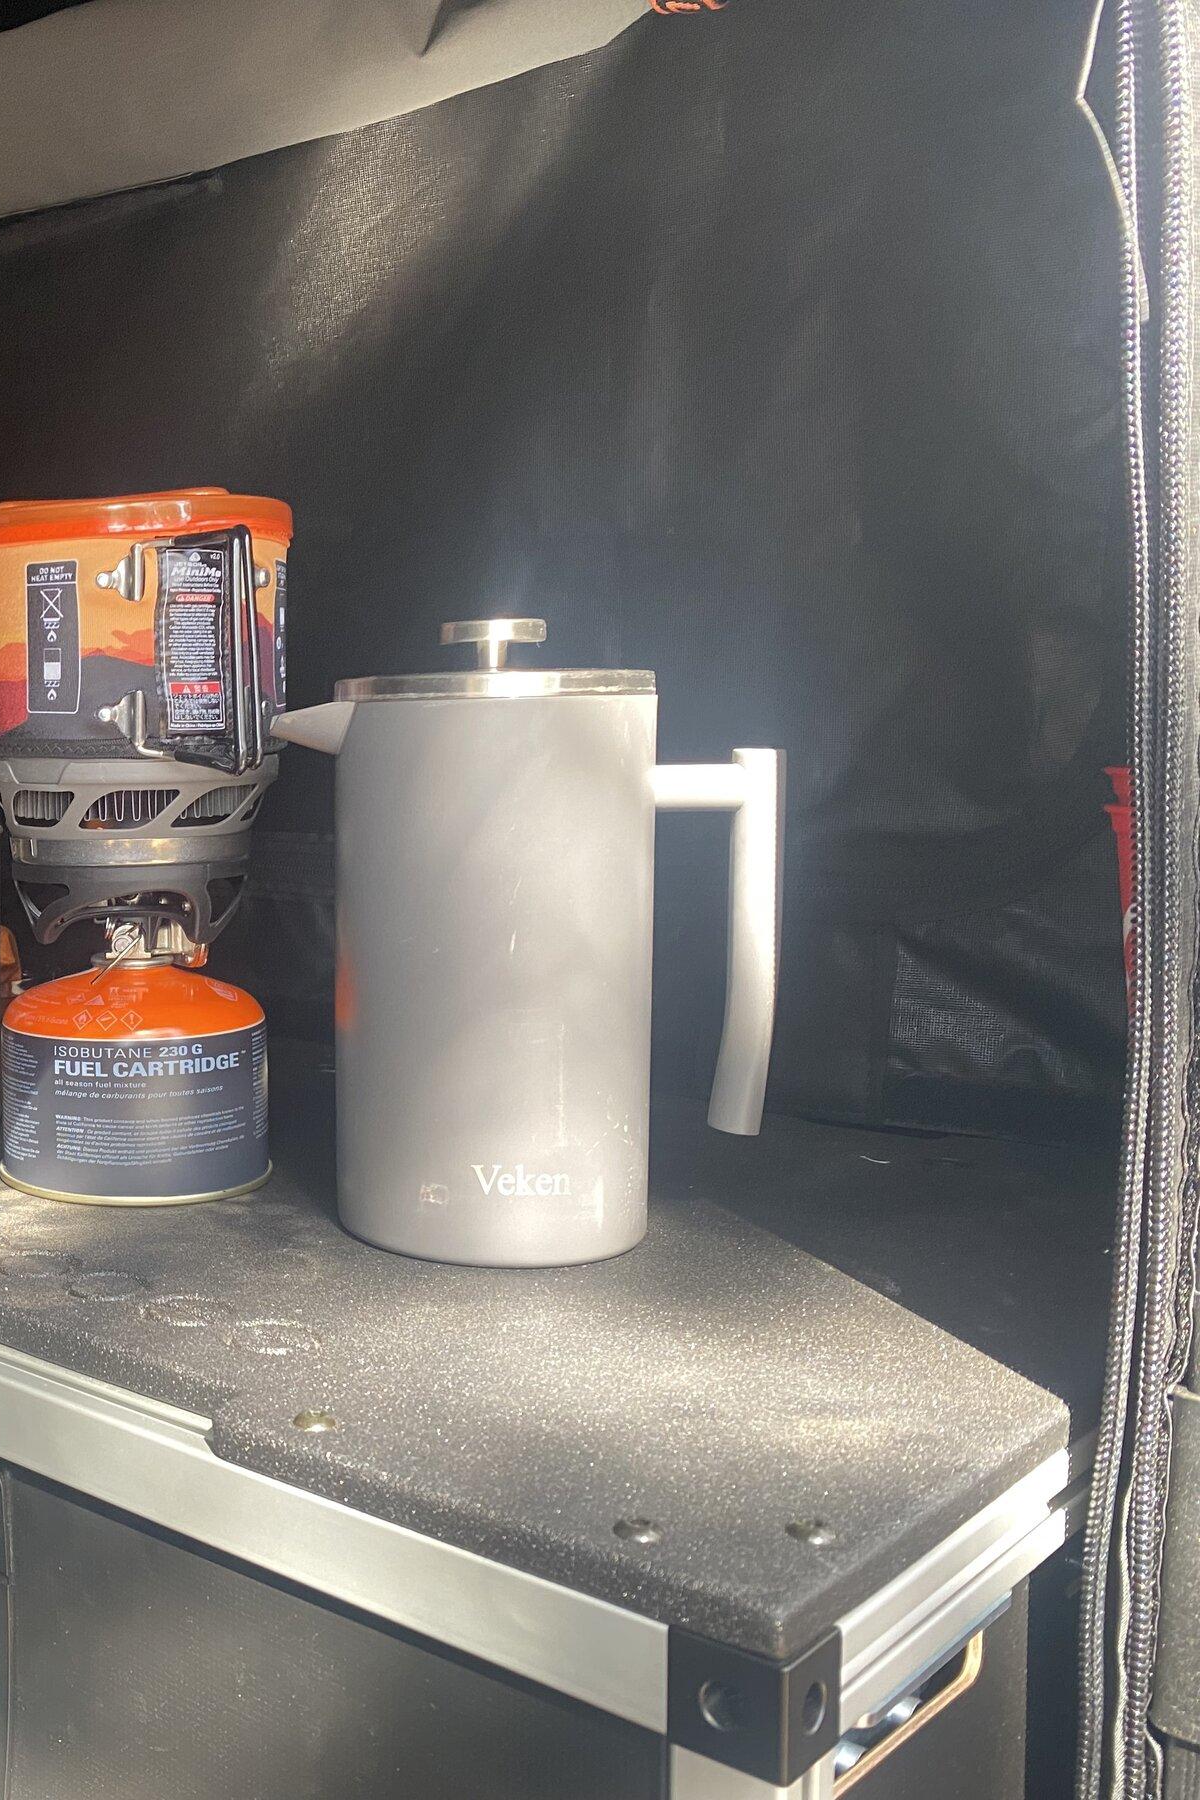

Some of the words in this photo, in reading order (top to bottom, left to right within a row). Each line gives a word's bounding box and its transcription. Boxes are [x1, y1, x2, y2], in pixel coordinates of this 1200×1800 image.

[31, 574, 48, 582] HEAT
[49, 573, 72, 581] EMPTY
[39, 567, 49, 575] DO
[50, 566, 64, 574] NOT
[54, 1045, 152, 1059] ISOBUTANE
[158, 1046, 188, 1058] 230
[191, 1044, 203, 1055] G
[54, 1059, 109, 1078] FUEL
[95, 1080, 112, 1088] fuel
[54, 1089, 88, 1099] mélange
[89, 1090, 100, 1099] de
[101, 1091, 146, 1100] carburants
[147, 1091, 167, 1100] pour
[169, 1088, 195, 1097] toutes
[196, 1084, 224, 1094] saisons
[470, 1163, 573, 1196] Veken
